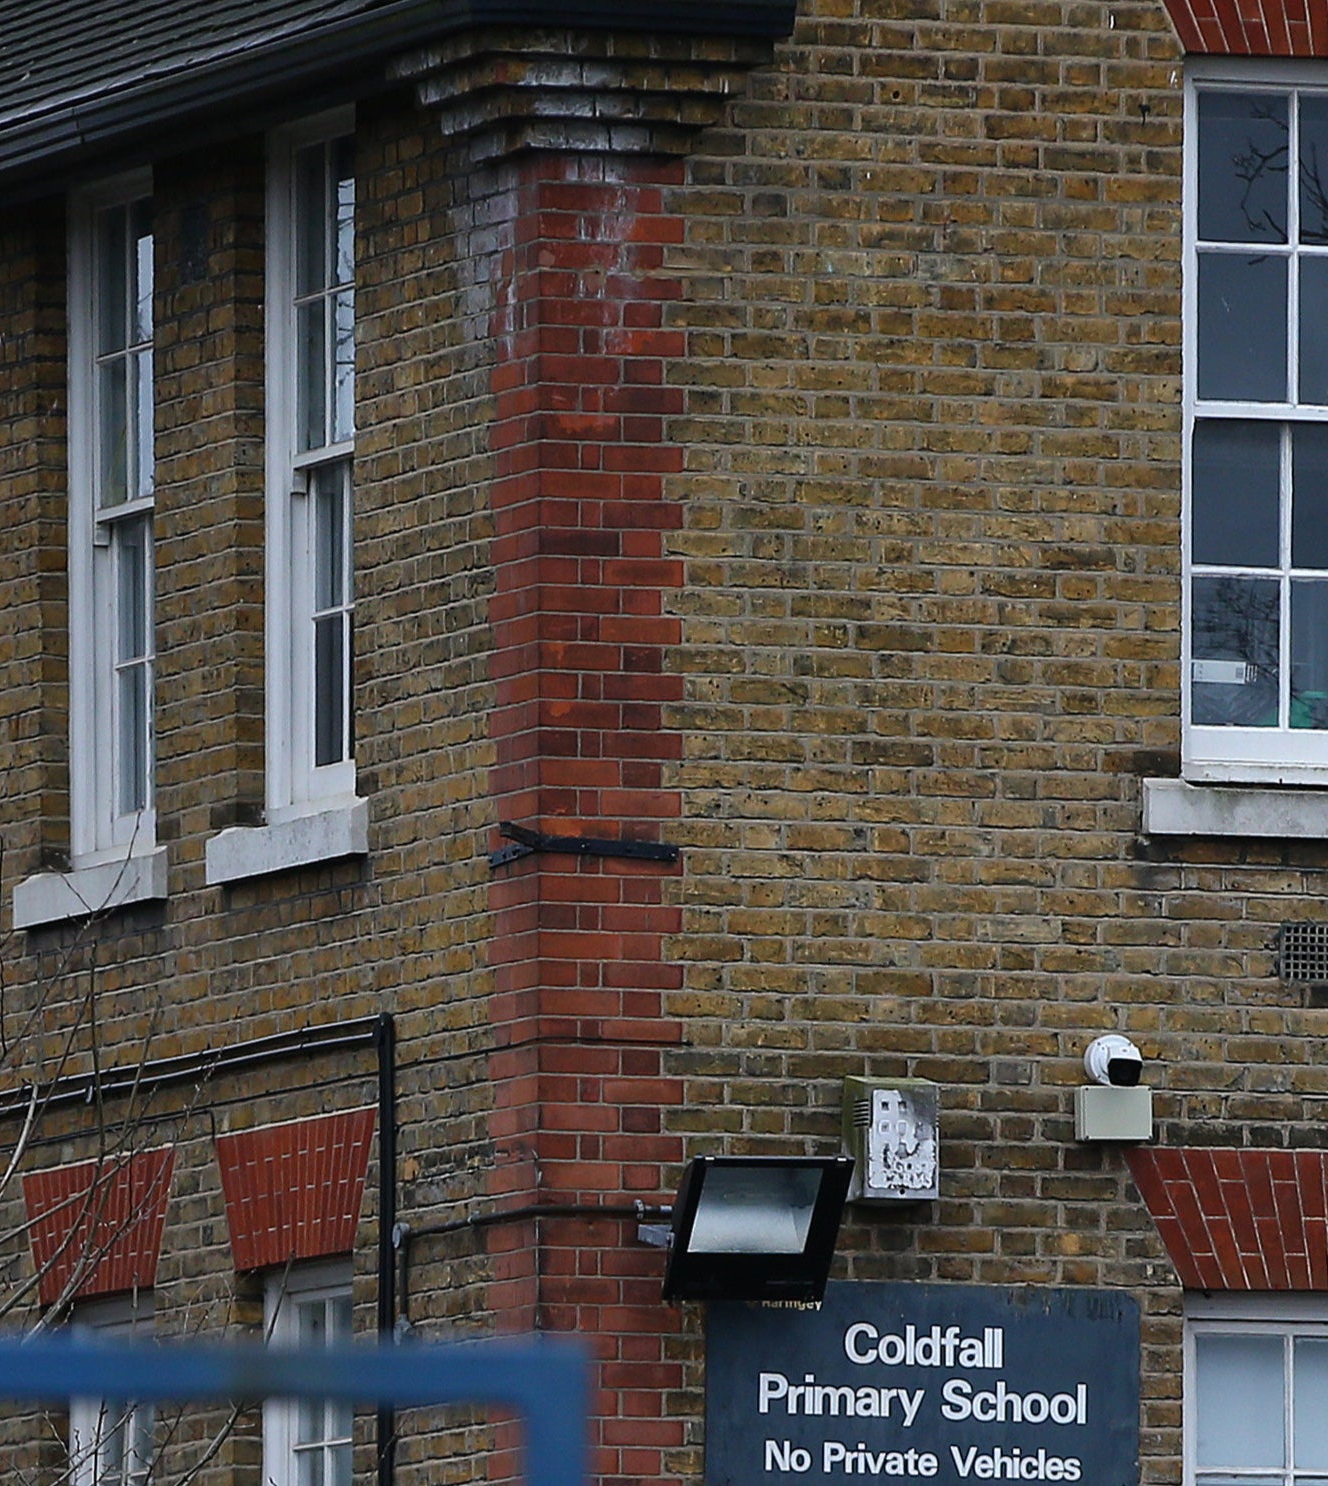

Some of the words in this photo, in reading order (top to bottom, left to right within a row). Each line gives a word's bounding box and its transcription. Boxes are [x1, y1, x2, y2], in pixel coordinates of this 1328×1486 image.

[844, 1322, 1003, 1368] Coldfall
[759, 1372, 925, 1427] Primary
[941, 1379, 1087, 1425] School
[765, 1440, 811, 1472] No
[823, 1441, 938, 1476] Private
[950, 1446, 1082, 1481] Vehicles
